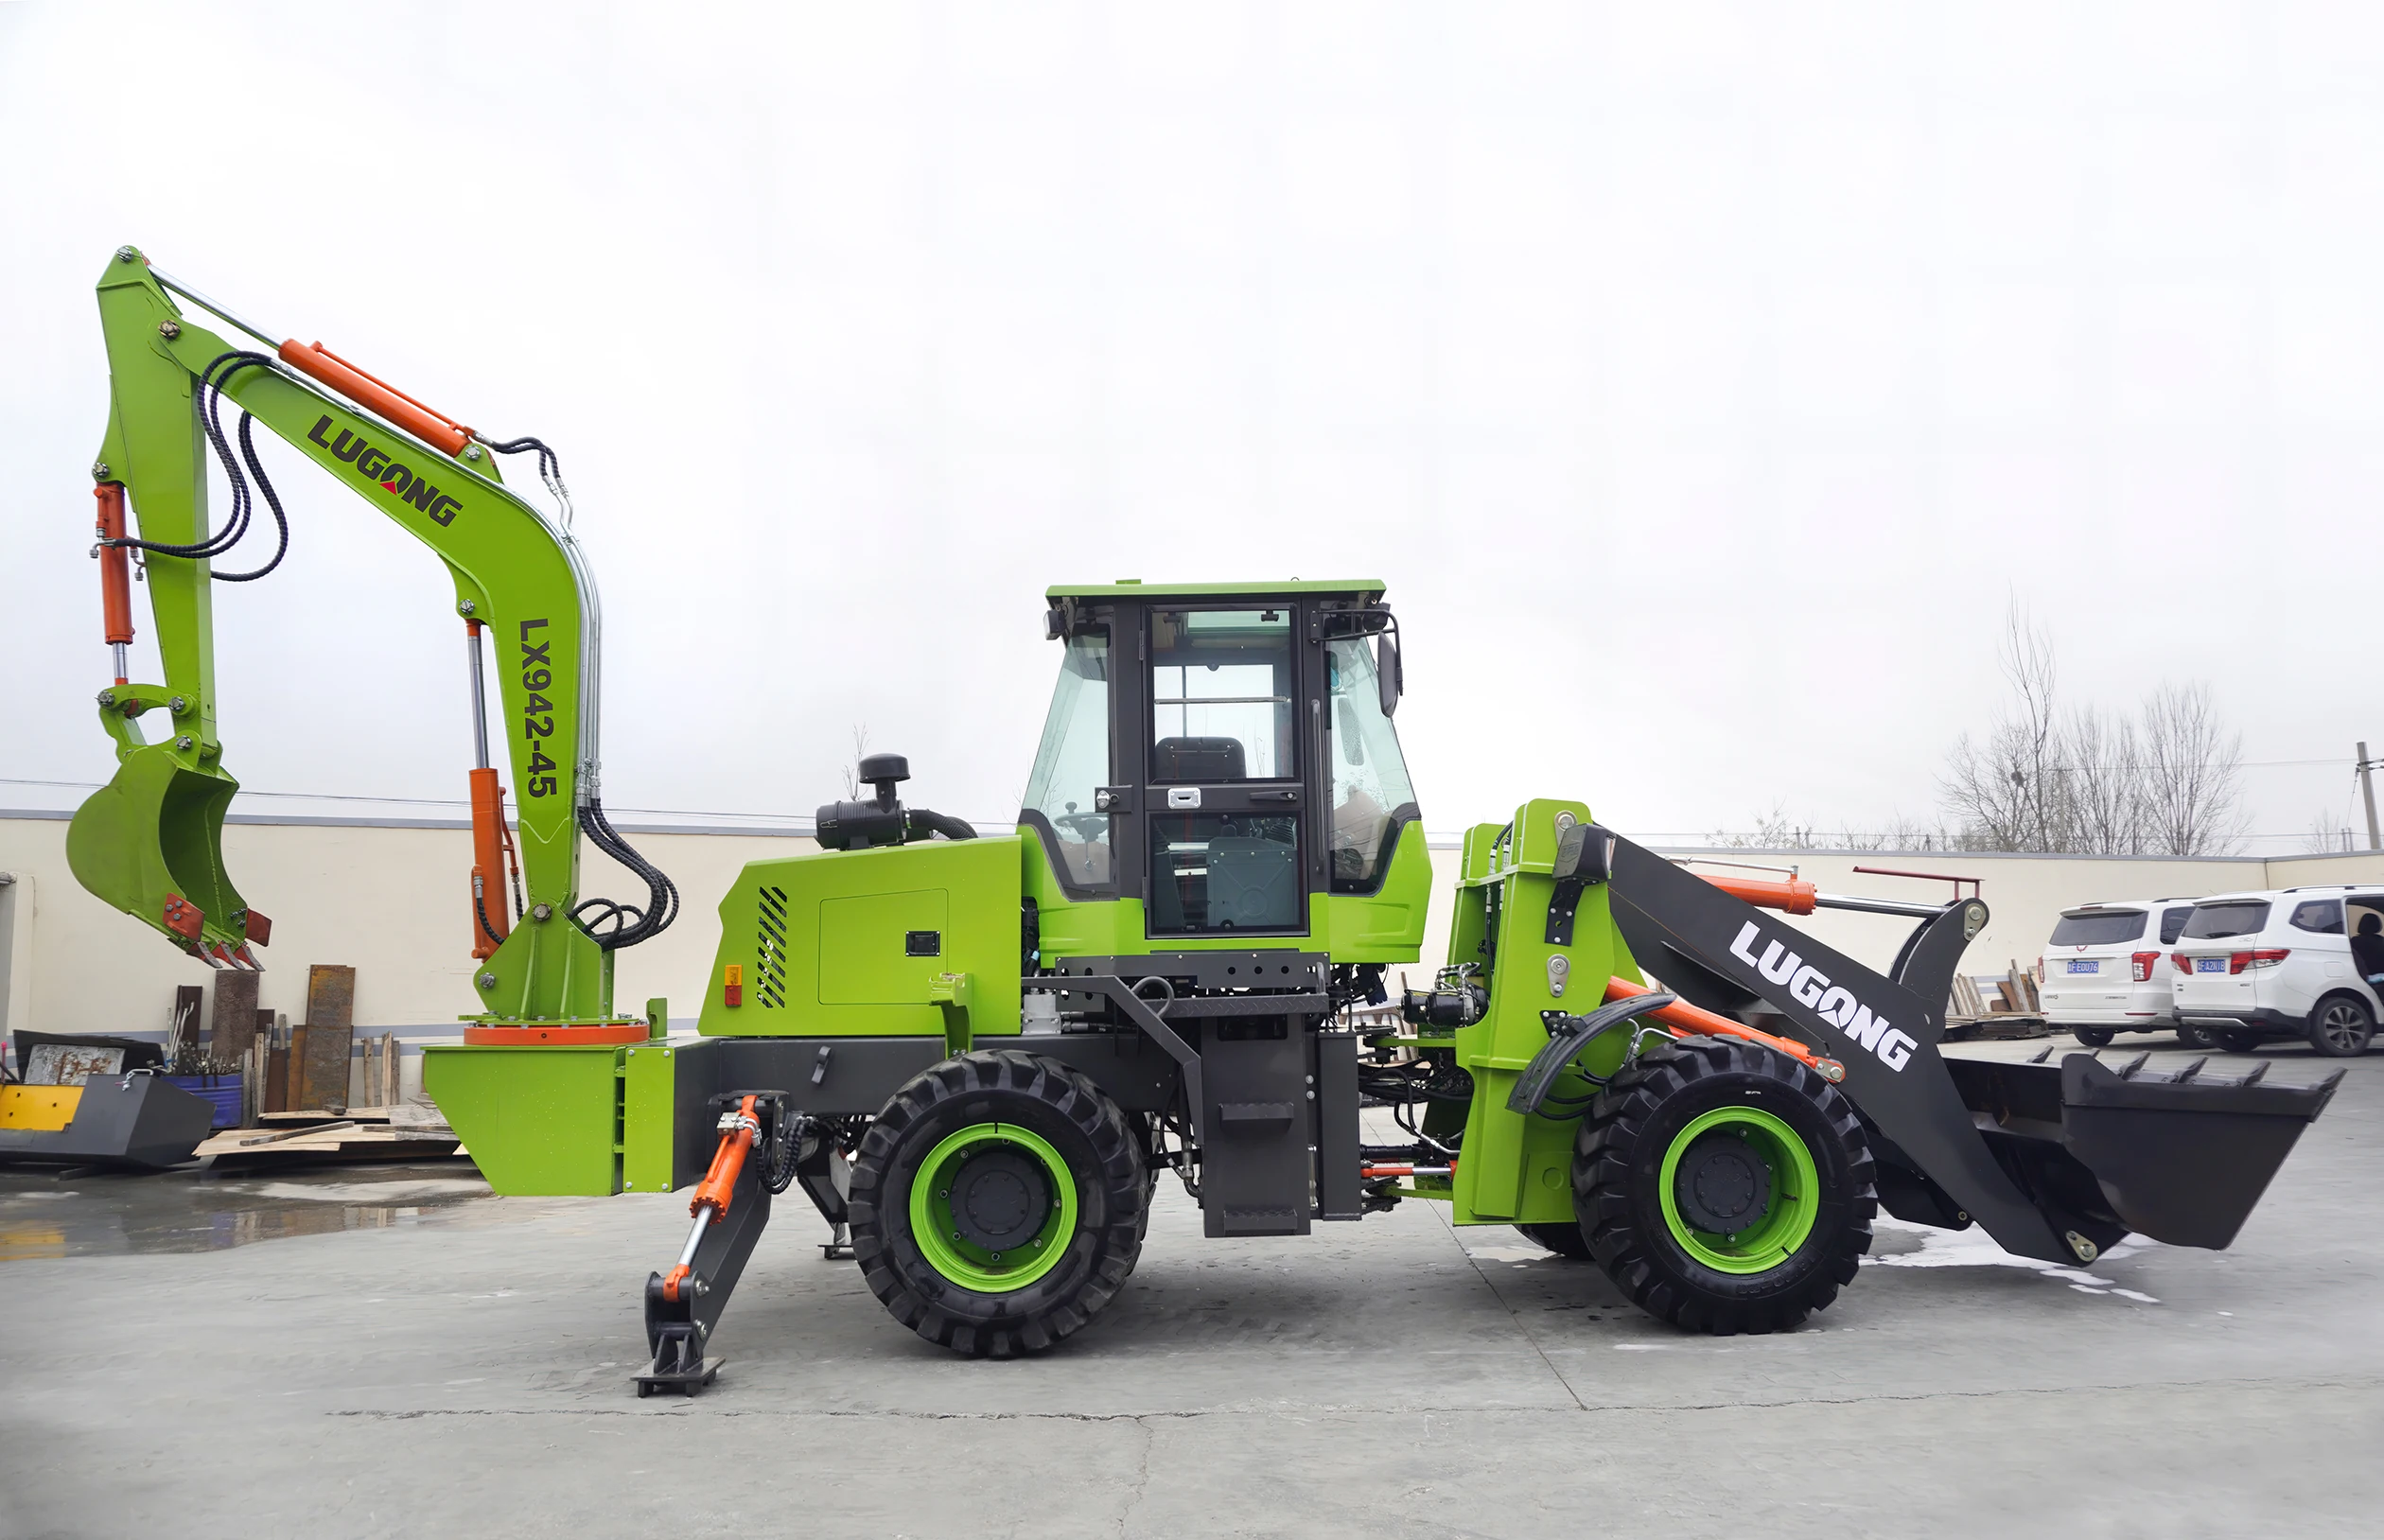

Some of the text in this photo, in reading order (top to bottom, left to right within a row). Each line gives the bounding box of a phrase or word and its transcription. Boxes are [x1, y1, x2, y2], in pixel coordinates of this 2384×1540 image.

[307, 414, 464, 527] LUGONG
[519, 618, 557, 797] LX942-45
[1729, 920, 1919, 1073] LUGONG
